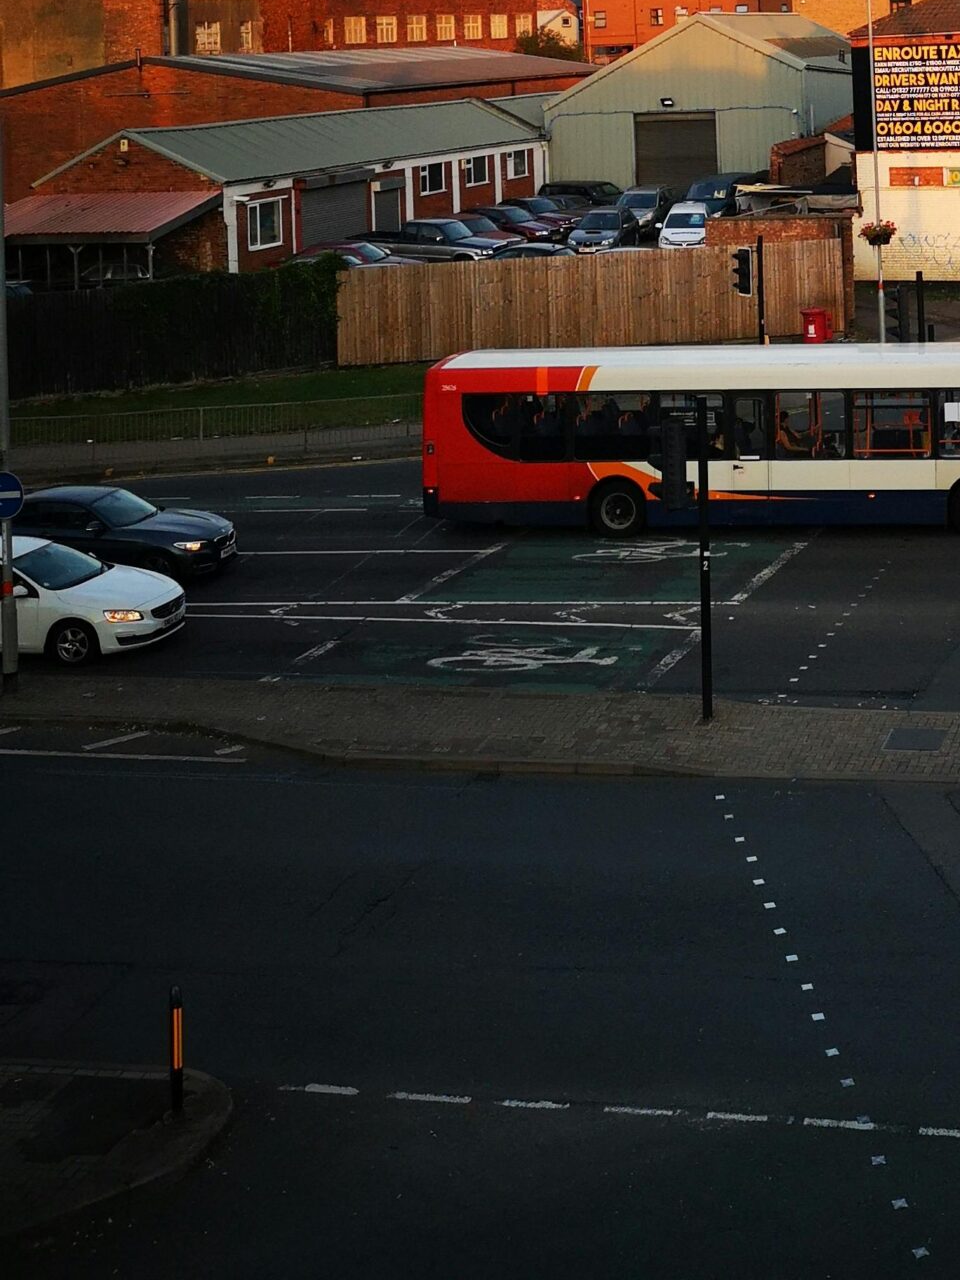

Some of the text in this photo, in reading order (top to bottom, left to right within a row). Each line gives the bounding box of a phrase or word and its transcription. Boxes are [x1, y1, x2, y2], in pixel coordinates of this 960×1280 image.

[874, 47, 938, 61] ENROUTE
[875, 73, 926, 87] DRIVERS
[876, 99, 900, 112] DAY
[902, 99, 911, 111] &
[914, 98, 951, 111] NIGHT
[877, 121, 922, 135] 01604
[703, 561, 709, 571] 2
